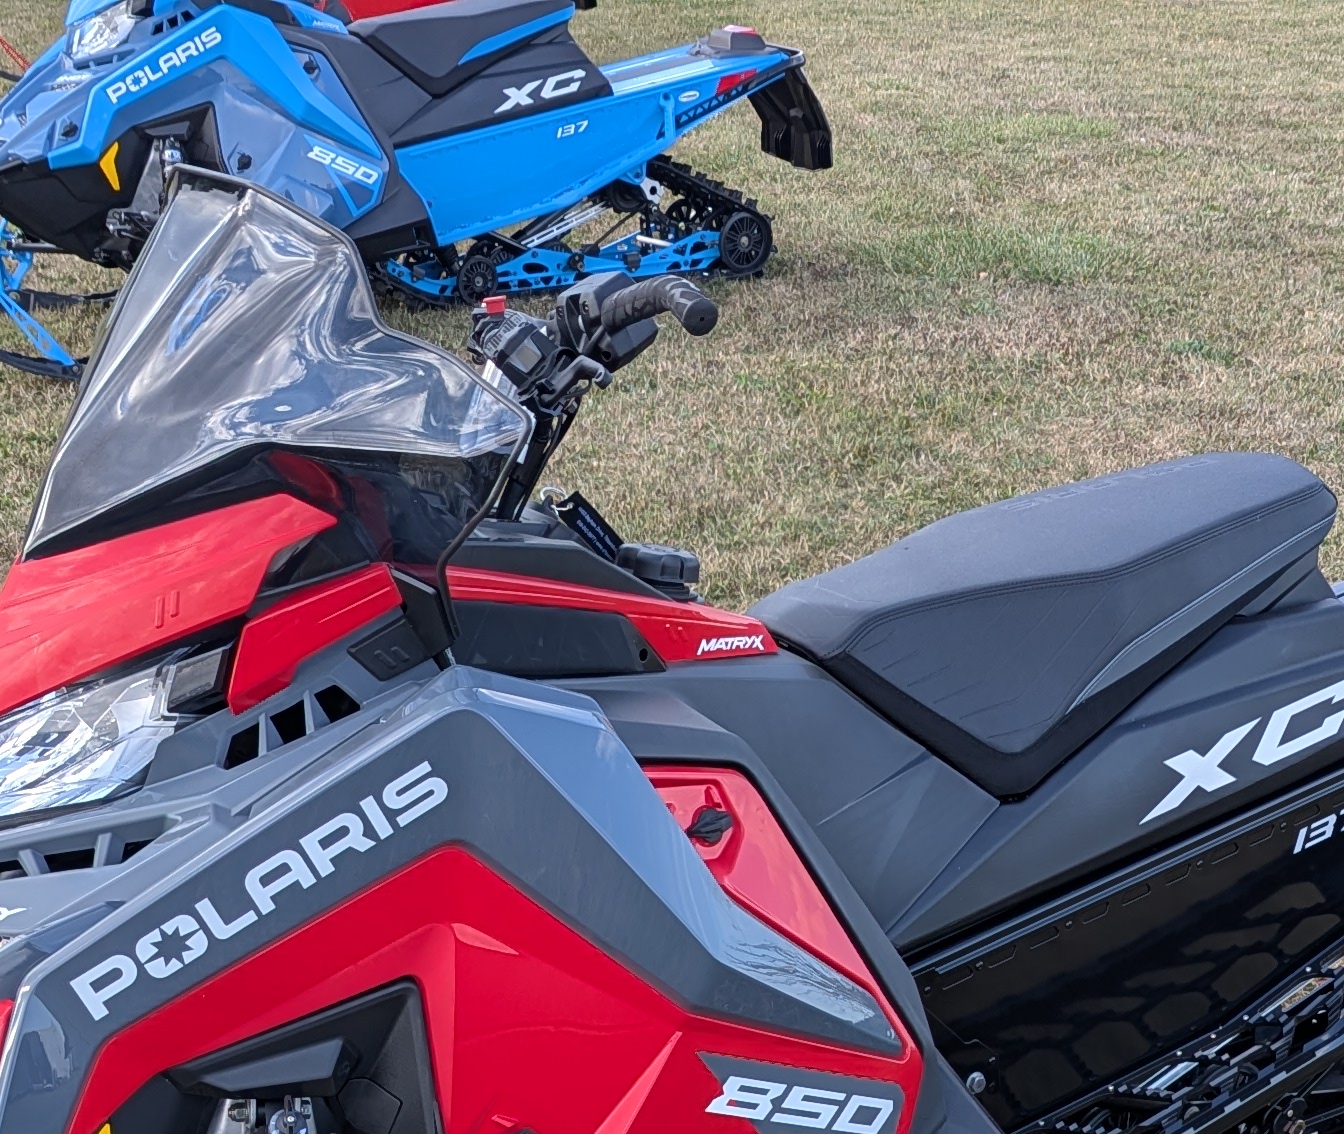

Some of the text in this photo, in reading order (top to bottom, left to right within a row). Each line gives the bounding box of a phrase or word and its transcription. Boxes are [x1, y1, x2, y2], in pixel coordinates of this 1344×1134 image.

[106, 26, 222, 104] POLARIS
[494, 68, 586, 114] XC
[557, 120, 588, 138] 137
[307, 146, 378, 184] 850
[697, 635, 764, 656] MATRYX
[69, 761, 449, 1021] POLARIS
